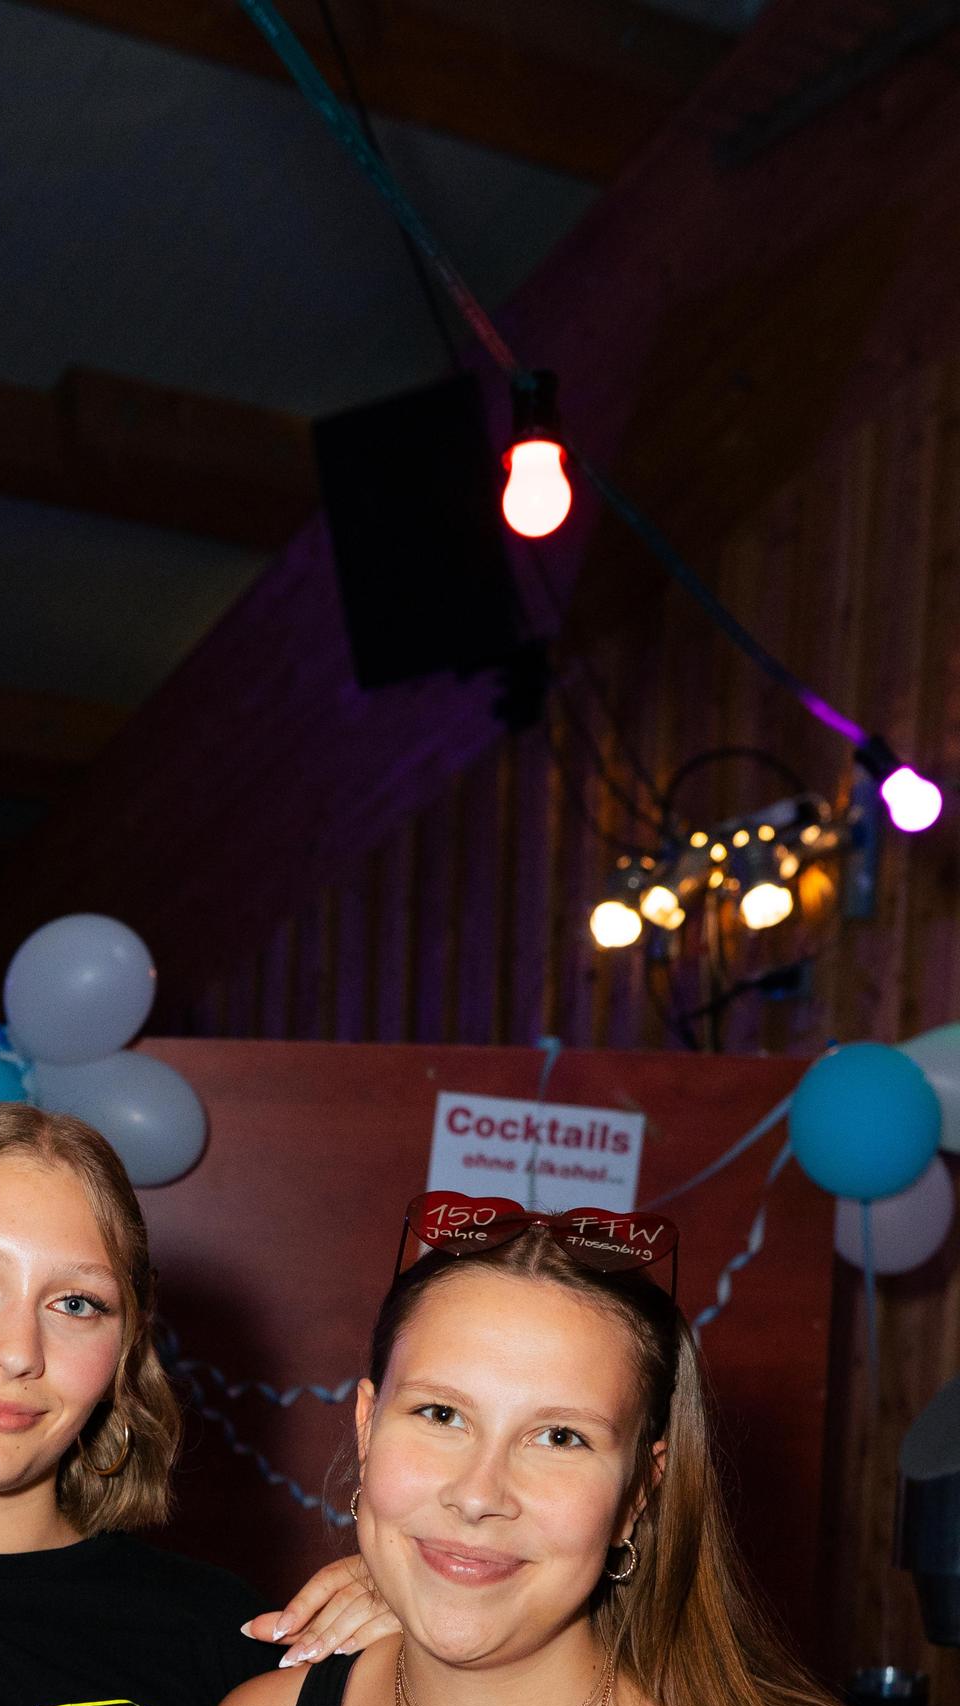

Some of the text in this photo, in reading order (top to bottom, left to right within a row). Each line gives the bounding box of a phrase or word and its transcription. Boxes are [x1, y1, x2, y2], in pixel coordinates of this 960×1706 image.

[446, 1106, 631, 1155] Cocktails
[462, 1153, 517, 1172] ohne
[426, 1204, 497, 1227] 150
[426, 1227, 488, 1241] Jahre
[571, 1216, 664, 1244] FFW
